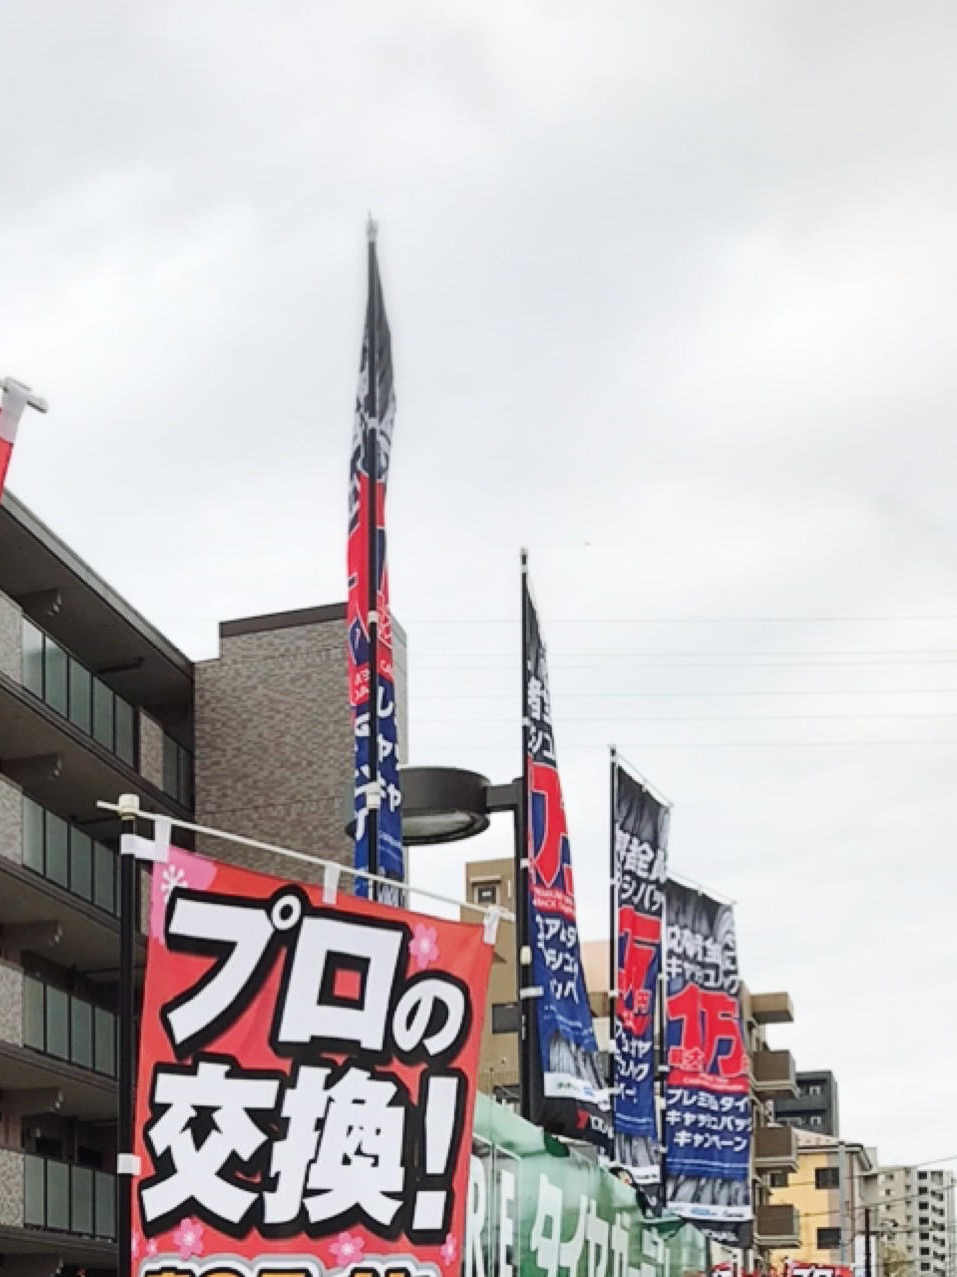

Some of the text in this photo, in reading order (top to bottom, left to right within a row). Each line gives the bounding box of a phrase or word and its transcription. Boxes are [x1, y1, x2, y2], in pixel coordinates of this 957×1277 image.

[162, 888, 468, 1058] プロの
[140, 1060, 460, 1232] 交換!
